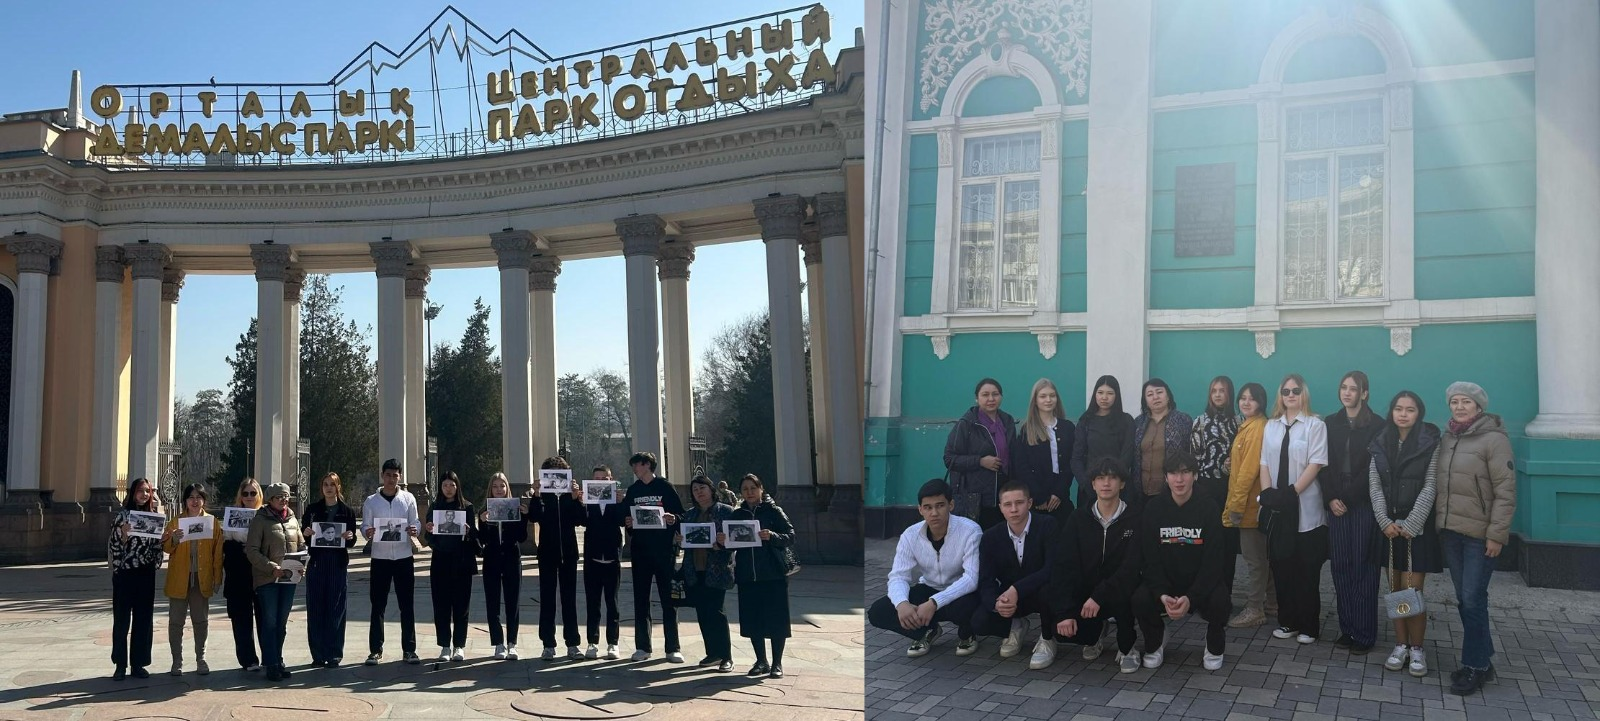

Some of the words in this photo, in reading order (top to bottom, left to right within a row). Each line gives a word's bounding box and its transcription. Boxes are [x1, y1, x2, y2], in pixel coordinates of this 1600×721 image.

[487, 5, 832, 106] ЦЕНТРАЛЬНЫЙ
[91, 85, 414, 119] ОРТАЛЫҚ
[487, 92, 601, 143] ПАРК
[612, 48, 836, 121] ОТДЫХА
[90, 122, 297, 156] ДЕМАЛЫС
[304, 118, 415, 155] ПАРКІ
[1160, 526, 1202, 538] FRIENDLY
